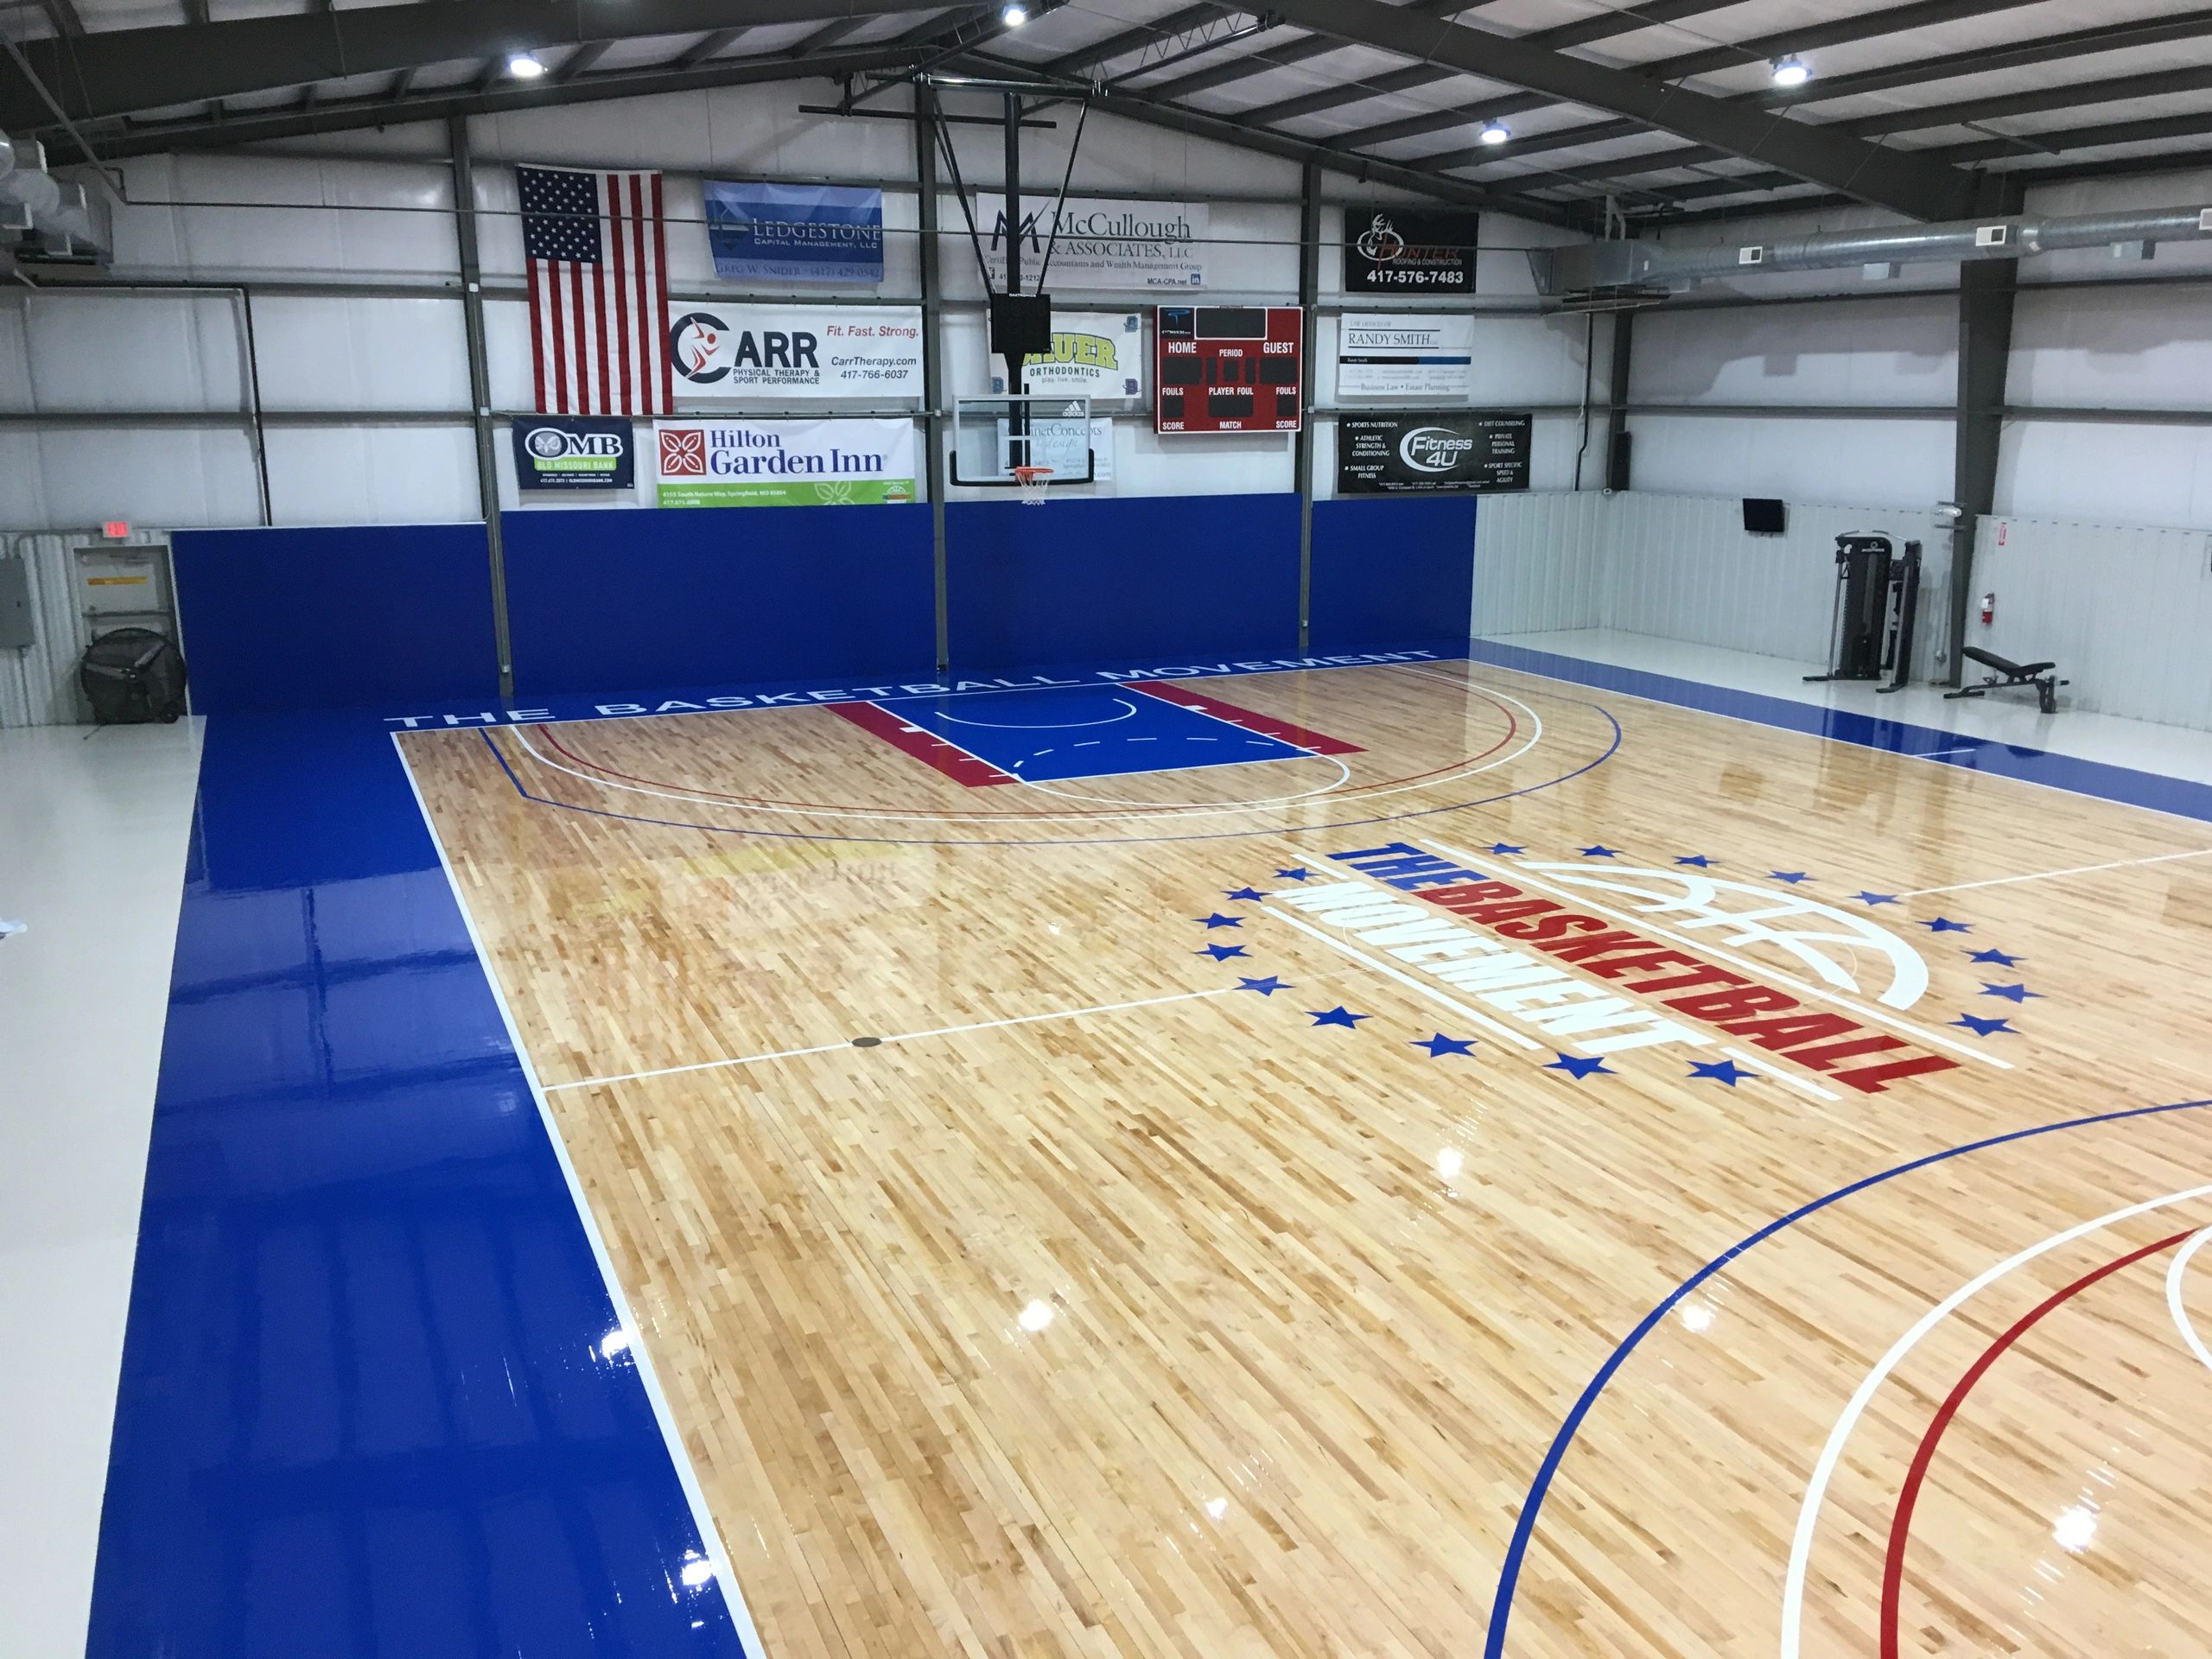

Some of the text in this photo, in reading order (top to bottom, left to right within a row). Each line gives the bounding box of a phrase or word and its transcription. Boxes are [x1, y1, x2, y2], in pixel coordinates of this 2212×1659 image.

[753, 218, 880, 241] LEDGESTONE
[1051, 211, 1192, 245] McCullough
[793, 239, 857, 249] MANAGEMENT,
[1050, 241, 1061, 255] &
[1065, 241, 1166, 259] ASSOCIATES,
[1106, 260, 1132, 270] Wealth
[1133, 262, 1179, 271] Management
[1179, 262, 1202, 272] Group
[1367, 270, 1464, 283] 417-576-7483
[826, 326, 919, 340] Fit. Fast. Strong.
[1348, 333, 1391, 345] RANDY
[1393, 334, 1430, 345] SMITH
[1168, 342, 1197, 353] HOME
[1263, 342, 1294, 353] GUEST
[830, 356, 917, 367] CarrTherapy.com
[733, 368, 820, 378] PHYSICAL THERAPY &
[840, 369, 909, 379] 417-766-6037
[1029, 365, 1100, 378] ORTHODONTICS
[1161, 387, 1184, 396] FOULS
[1208, 387, 1235, 396] PLAYER
[1275, 386, 1297, 395] FOULS
[1162, 422, 1185, 430] SCORE
[1219, 421, 1242, 429] MATCH
[1275, 420, 1297, 429] SCORE
[526, 429, 621, 458] OMB
[710, 429, 781, 448] Hilton
[1410, 435, 1473, 456] Fitness
[710, 448, 883, 475] Garden Inn
[1426, 450, 1458, 467] 4U
[537, 461, 613, 469] OLD MISSOURI BANK
[384, 650, 1441, 728] THE BASKETBALL MOVEMENT
[1268, 880, 1718, 1054] MOVEMENT
[1414, 880, 1963, 1095] BASKETBALL
